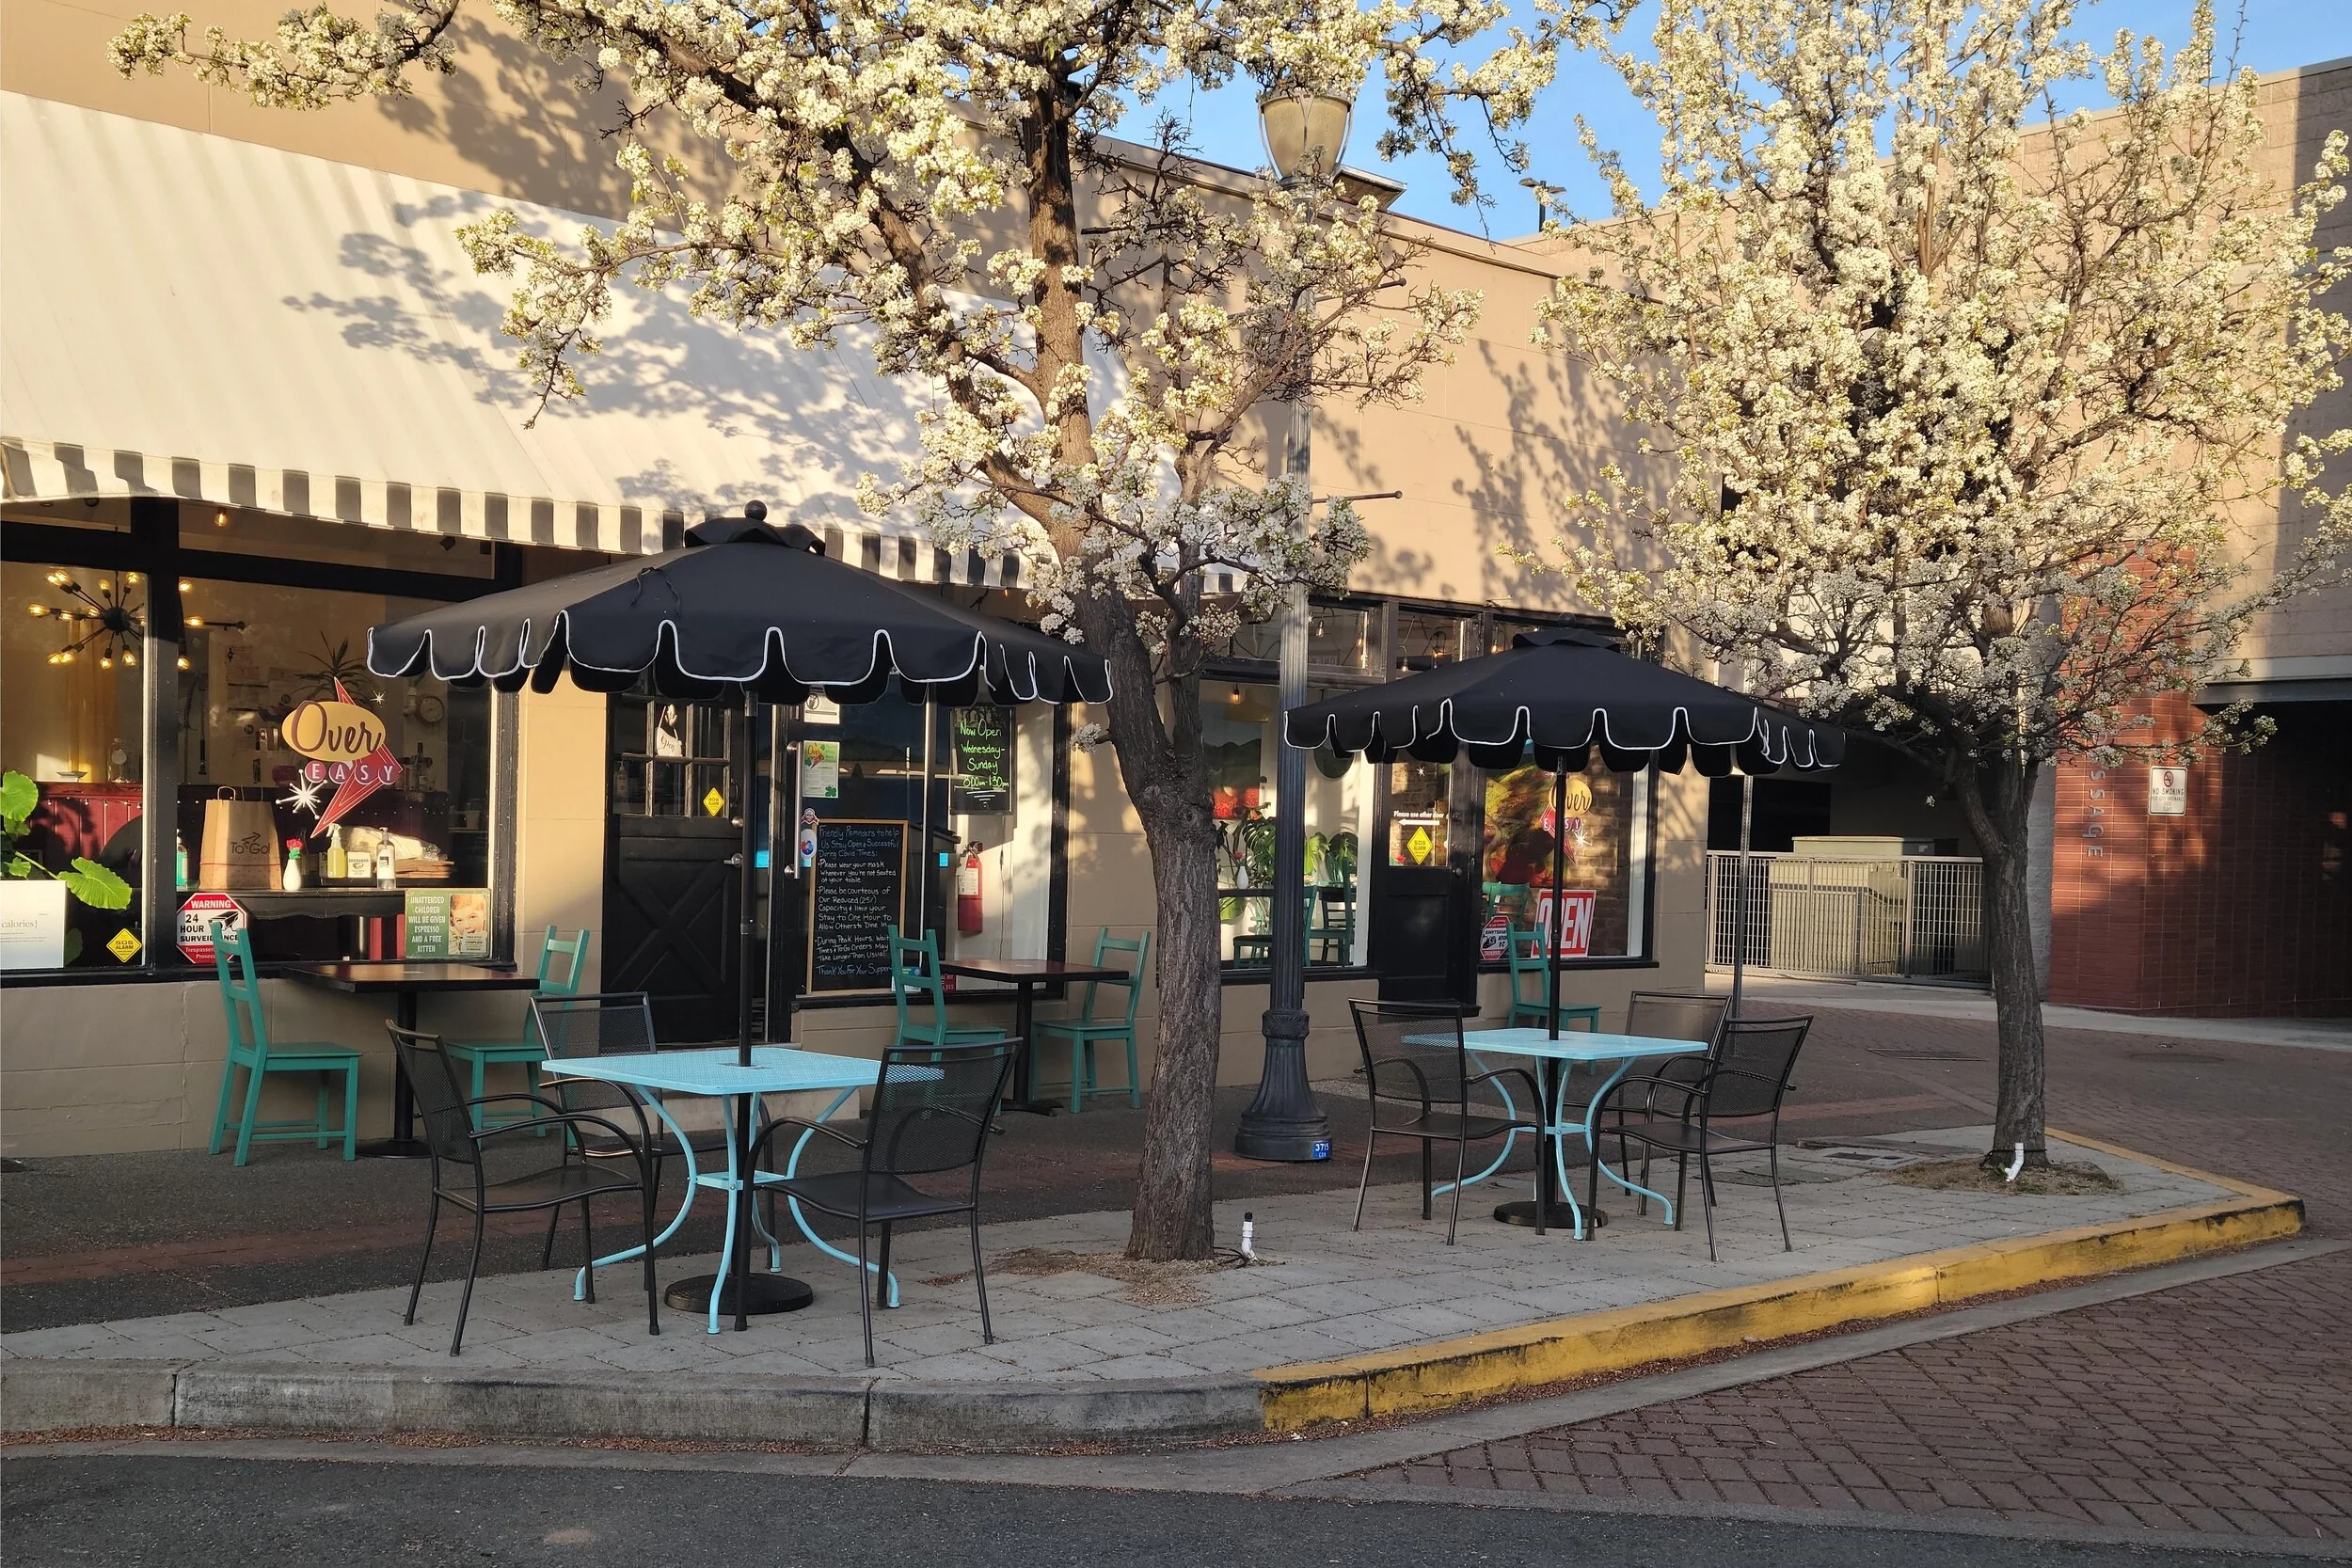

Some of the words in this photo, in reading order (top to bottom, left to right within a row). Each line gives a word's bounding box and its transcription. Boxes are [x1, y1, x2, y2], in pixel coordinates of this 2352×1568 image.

[291, 700, 382, 753] Over
[961, 719, 976, 736] Now
[978, 719, 1002, 740] Open
[967, 757, 998, 775] Sunday
[311, 763, 393, 782] EASY
[1544, 817, 1580, 829] ESY
[831, 840, 846, 851] Stay
[848, 840, 863, 848] Open
[866, 838, 899, 847] Successful
[818, 849, 837, 859] During
[819, 859, 837, 868] Please
[818, 886, 837, 895] Please
[847, 886, 880, 895] courteous
[191, 900, 231, 909] WARNING
[410, 895, 445, 904] UNATTENDED
[818, 904, 848, 913] Capacity
[185, 913, 199, 923] 24
[408, 915, 421, 924] WILL
[430, 915, 445, 924] GIVEN
[818, 912, 835, 924] Stay
[1535, 897, 1593, 949] OEN
[180, 925, 204, 933] HOUR
[817, 936, 836, 946] During
[875, 943, 889, 952] May
[867, 962, 893, 974] Suppor
[1315, 1143, 1329, 1151] 3715
